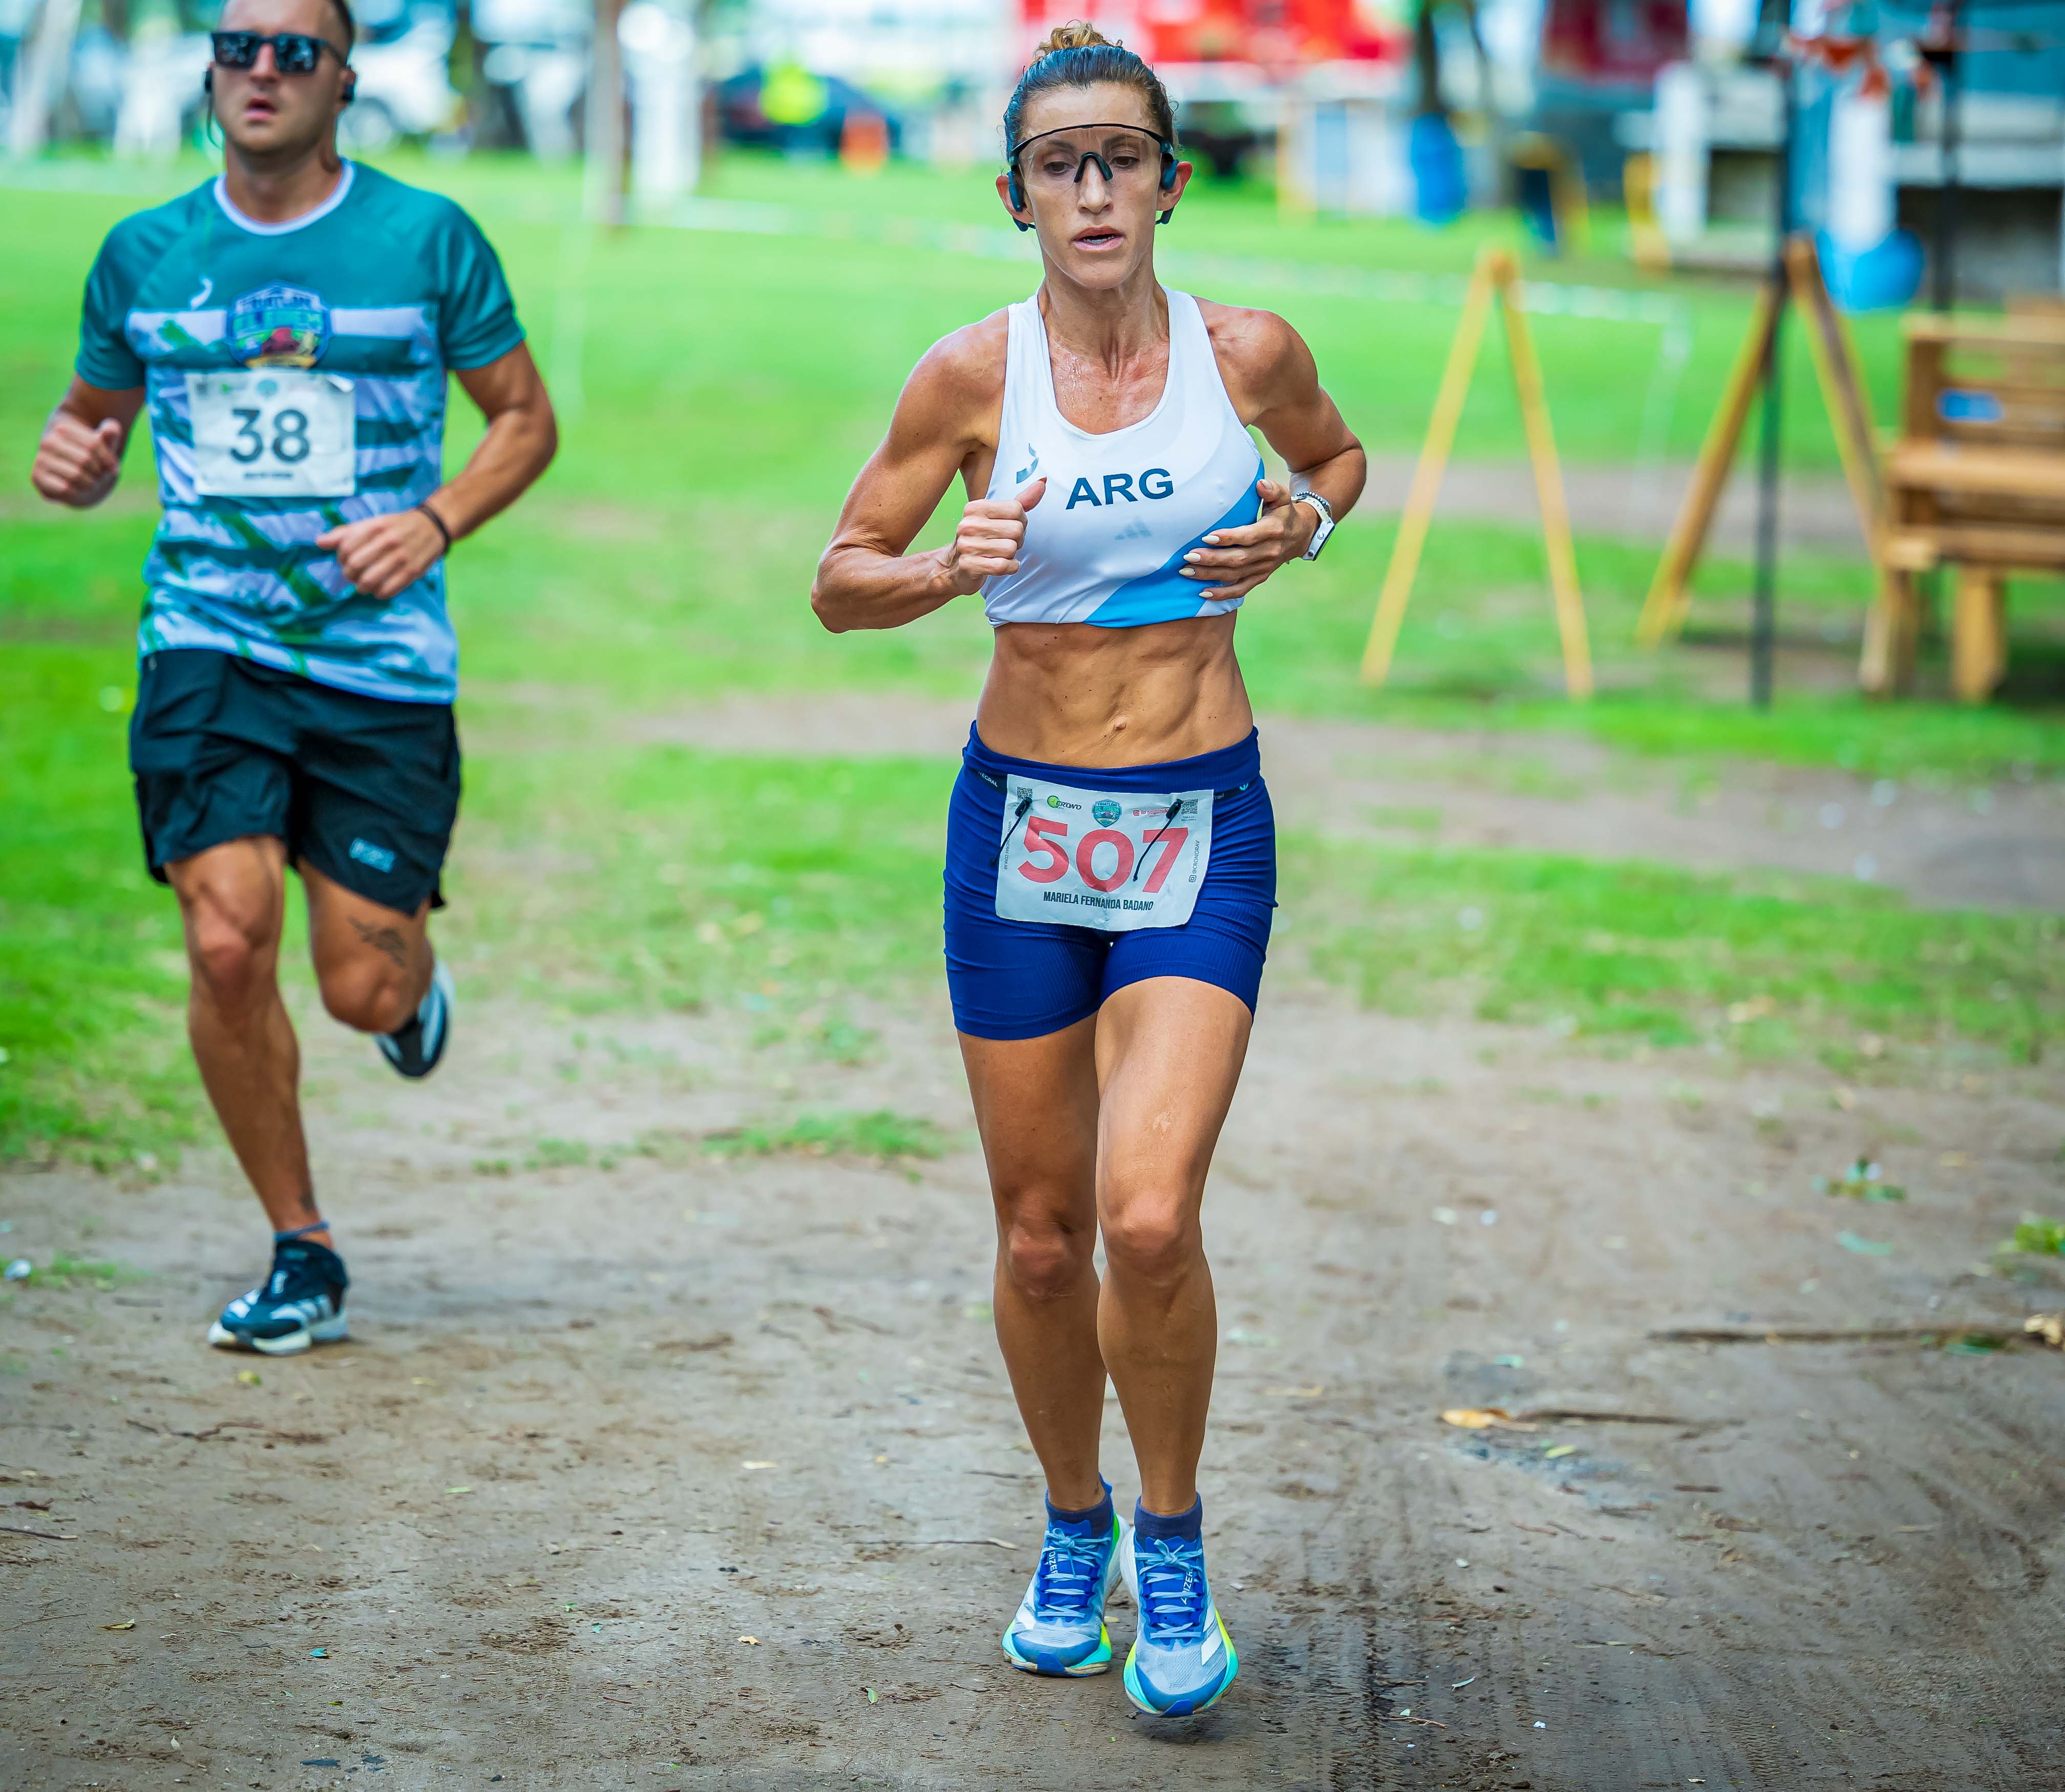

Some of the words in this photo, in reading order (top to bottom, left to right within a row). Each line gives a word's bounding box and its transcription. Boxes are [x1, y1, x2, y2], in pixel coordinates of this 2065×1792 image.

[230, 408, 310, 463] 38
[1065, 468, 1174, 510] ARG
[1018, 815, 1189, 893] 507
[1192, 840, 1200, 874] @CRONORAV
[1043, 891, 1079, 904] MARIELA
[1081, 895, 1121, 909] FERNANDA
[1123, 899, 1153, 911] BADANO
